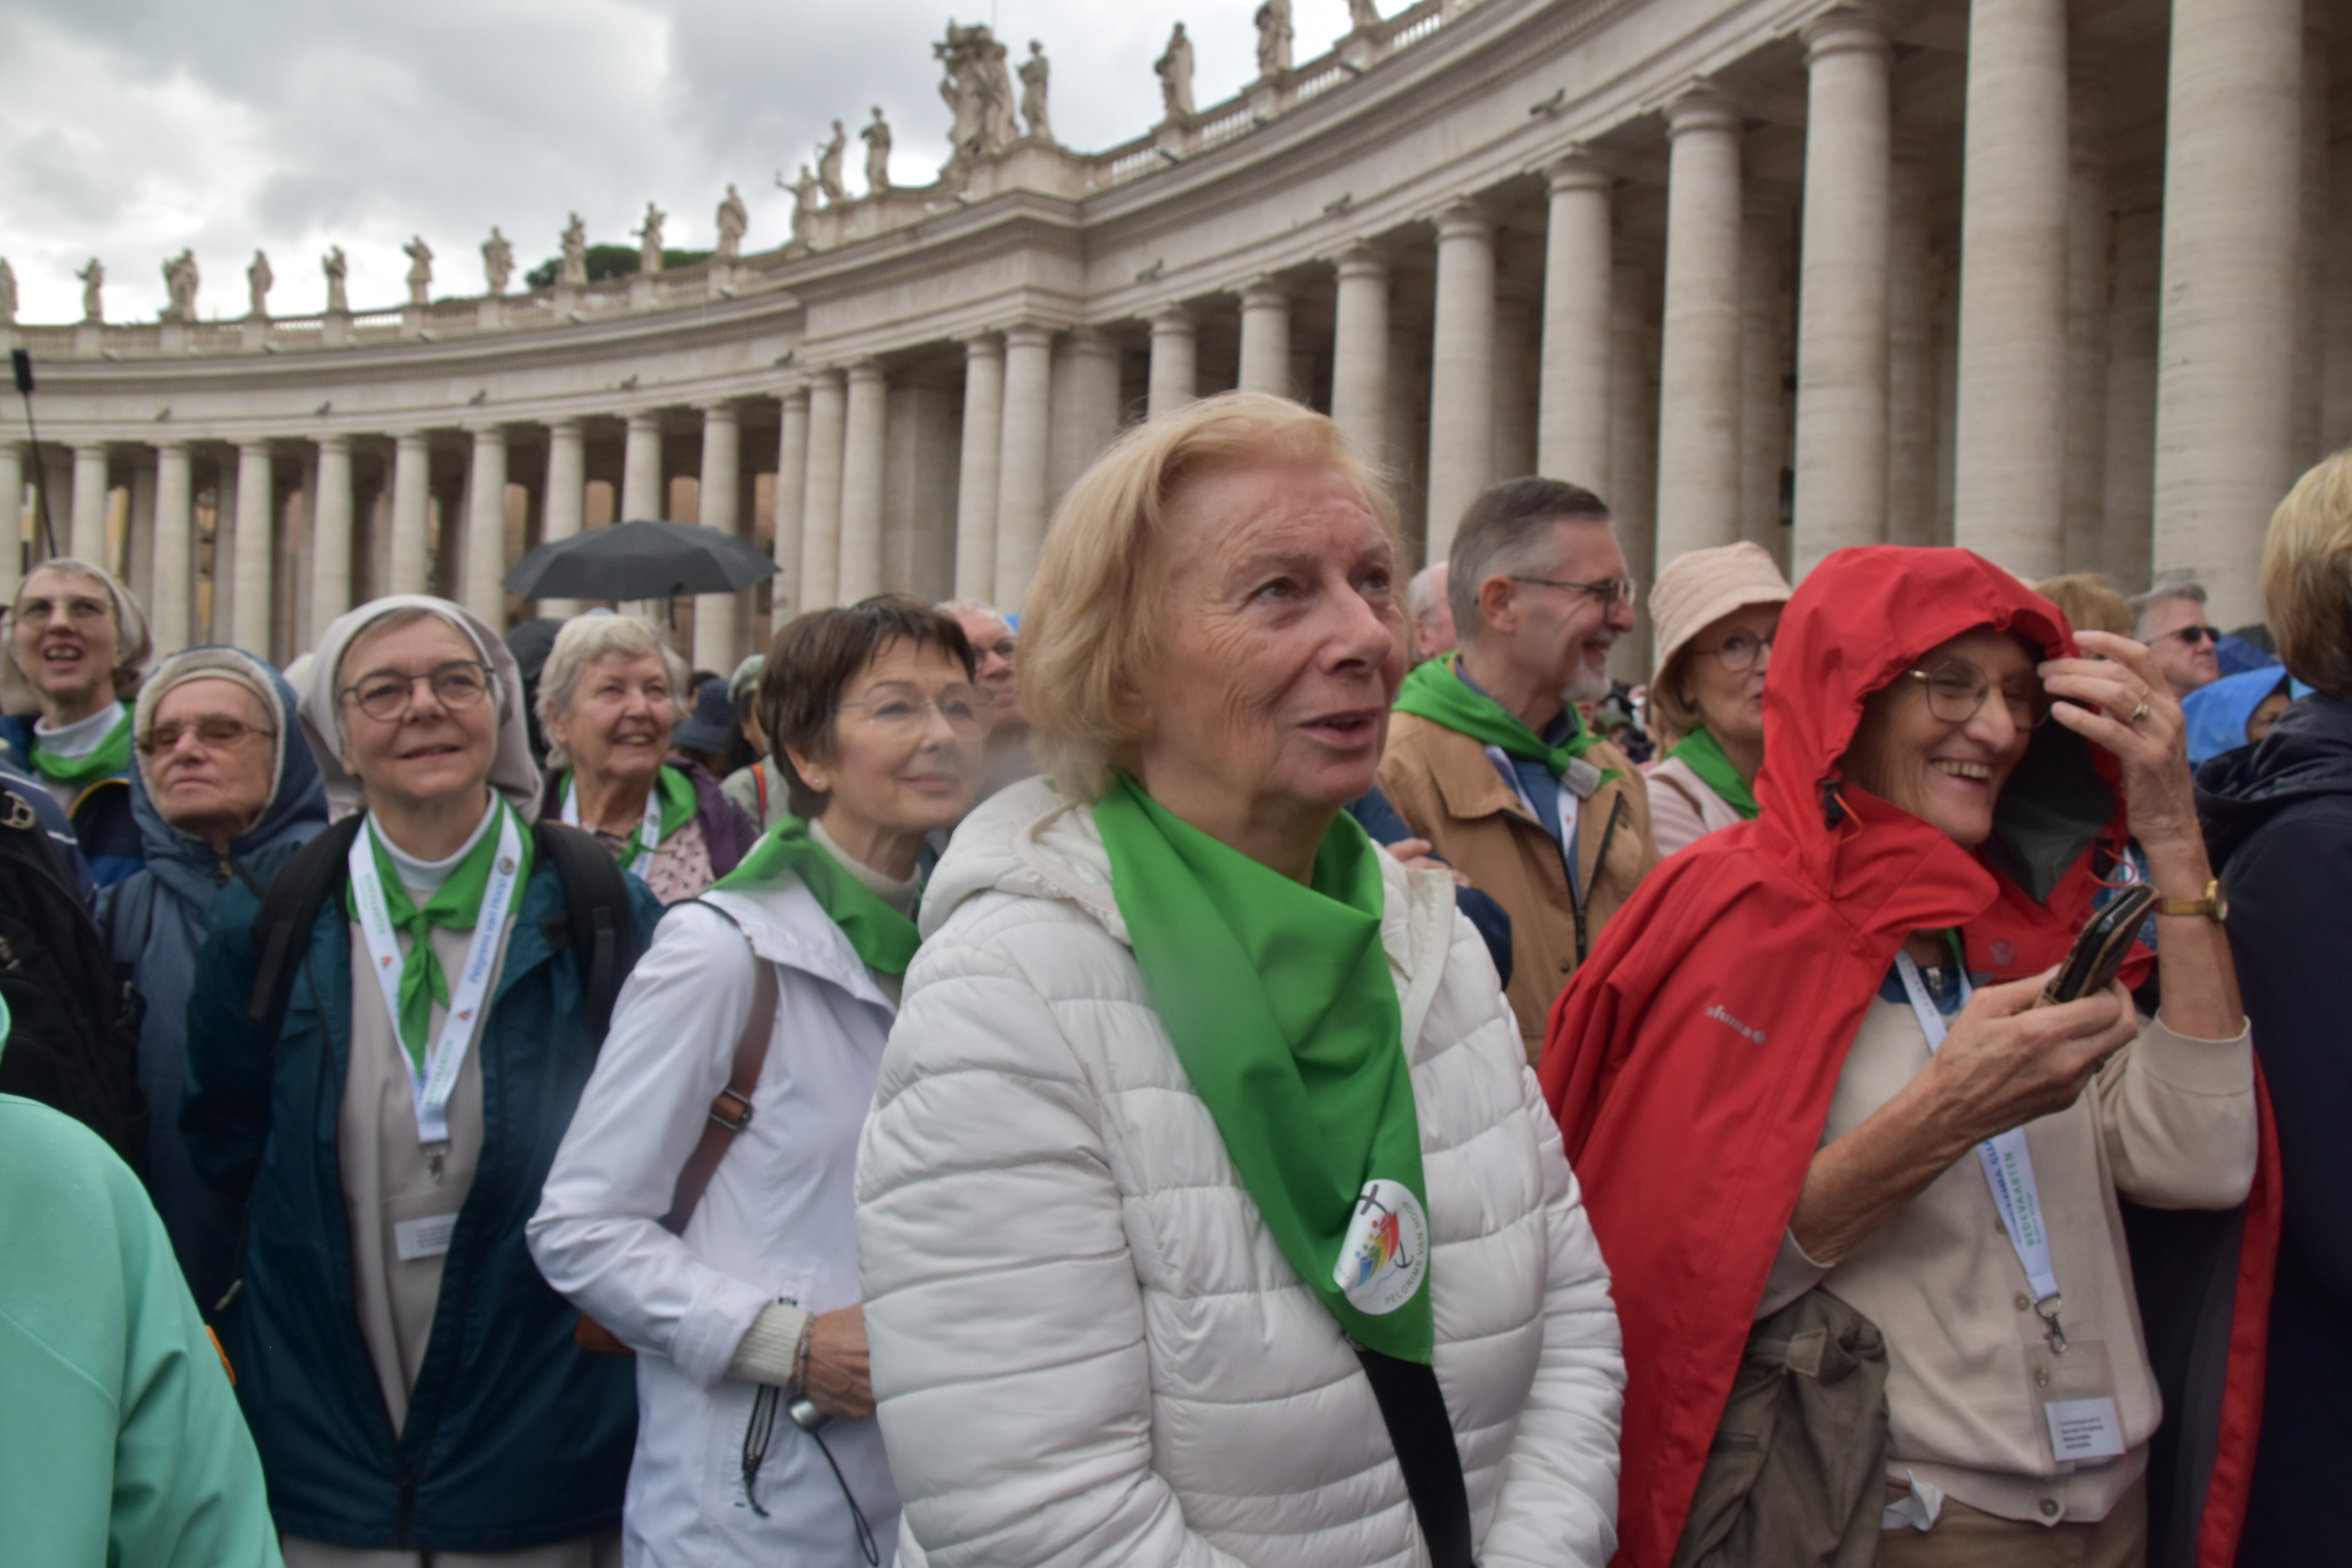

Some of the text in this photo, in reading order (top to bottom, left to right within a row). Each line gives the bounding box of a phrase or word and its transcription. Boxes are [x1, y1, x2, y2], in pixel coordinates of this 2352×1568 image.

[484, 909, 497, 932] van
[2004, 1152, 2036, 1247] BEDEVAARTEN
[1385, 1261, 1422, 1305] PELGRIMS
